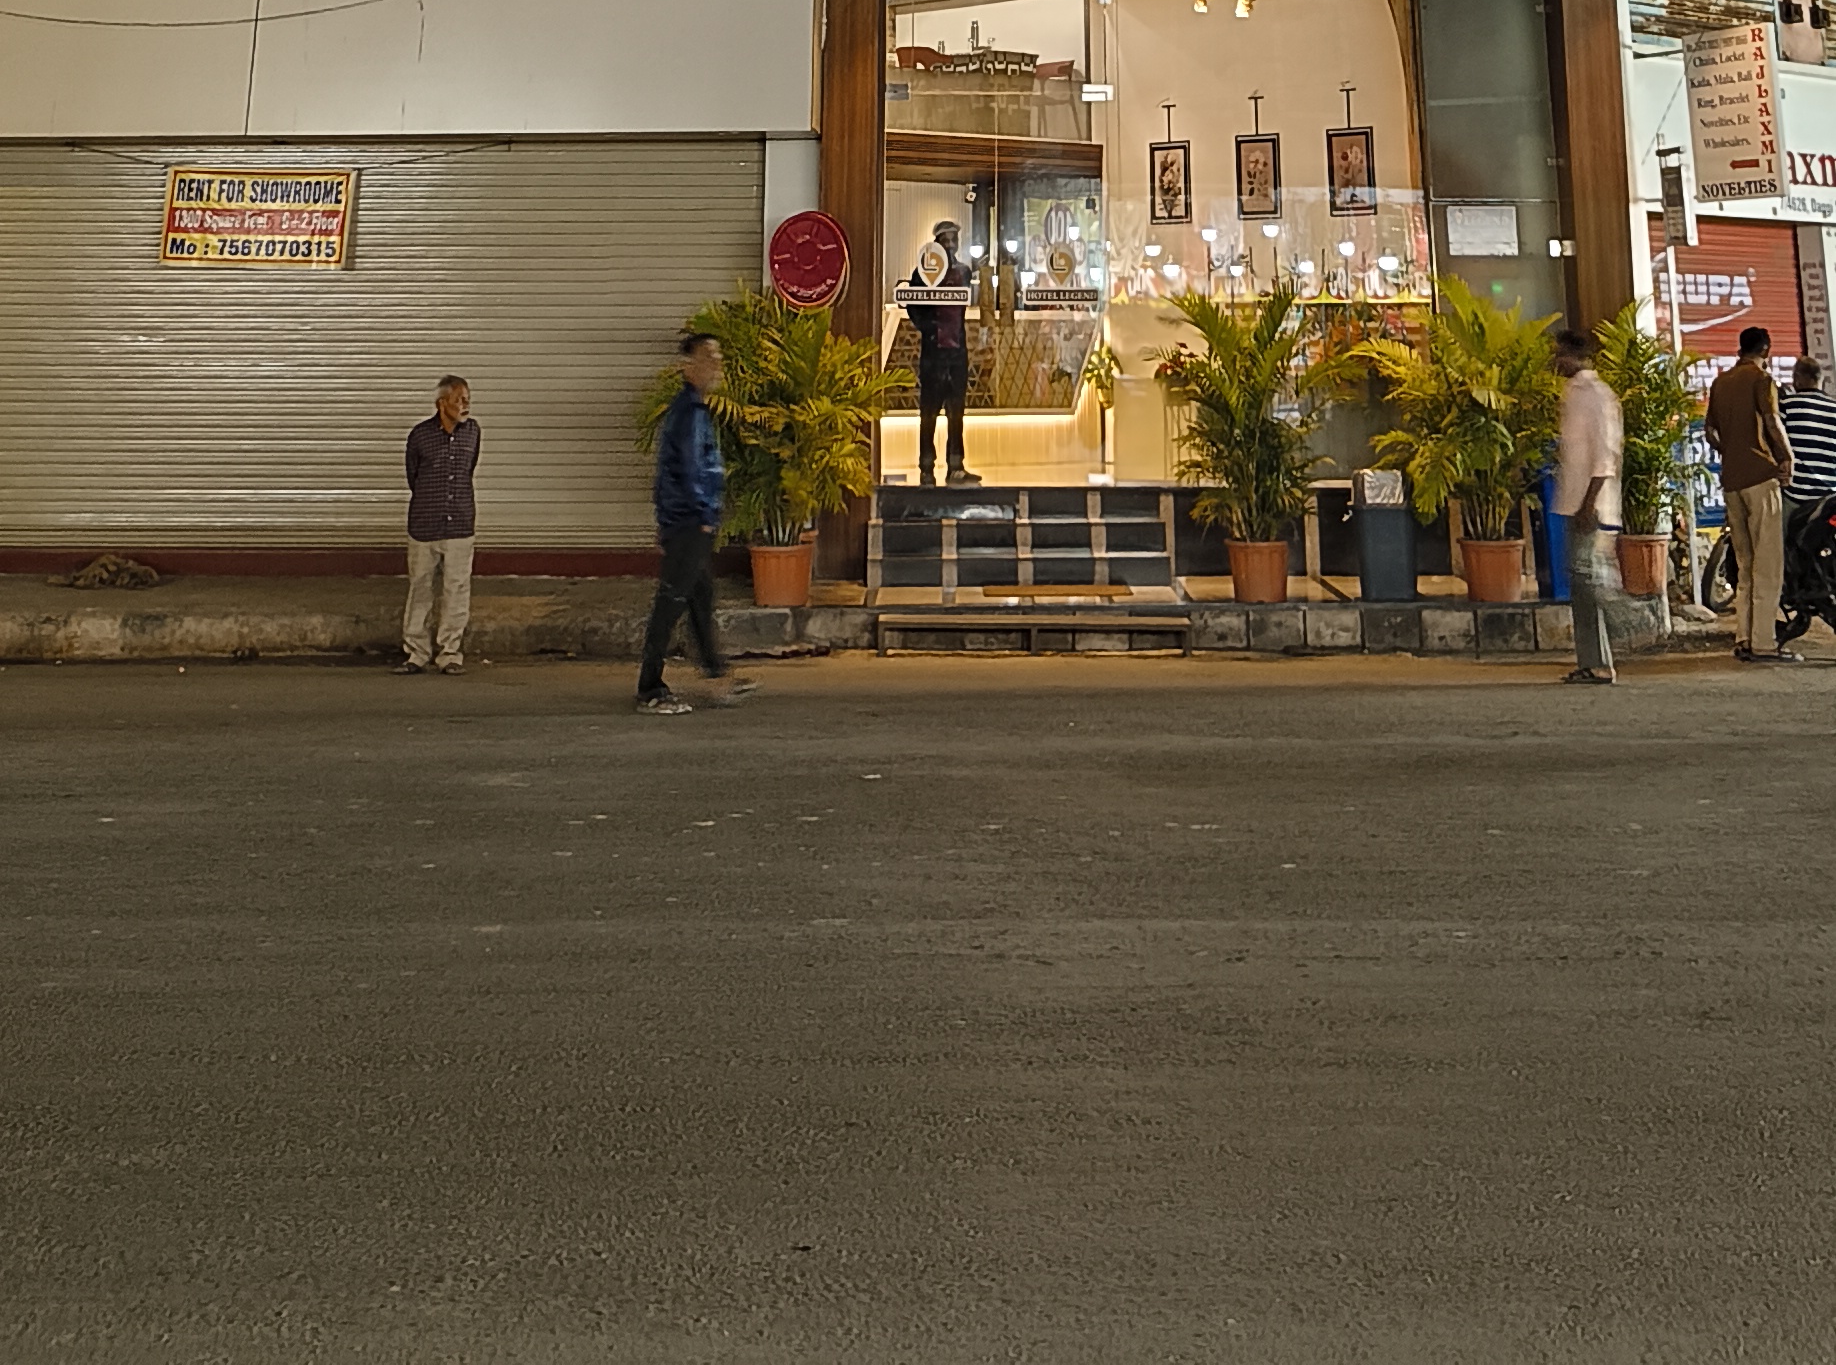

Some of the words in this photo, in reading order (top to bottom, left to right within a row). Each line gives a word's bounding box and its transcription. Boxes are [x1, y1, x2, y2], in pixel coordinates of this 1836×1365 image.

[175, 178, 213, 202] RENT
[217, 179, 245, 203] FOR
[249, 180, 344, 205] SHOWROOME
[1701, 178, 1778, 198] NOVELTIES
[203, 210, 241, 233] Square
[169, 237, 197, 255] Mo
[217, 239, 337, 257] 7567070315
[897, 290, 929, 300] HOTEL
[930, 290, 968, 301] LEGEND
[1027, 290, 1059, 300] HOTEL
[1059, 290, 1097, 301] LEGEND
